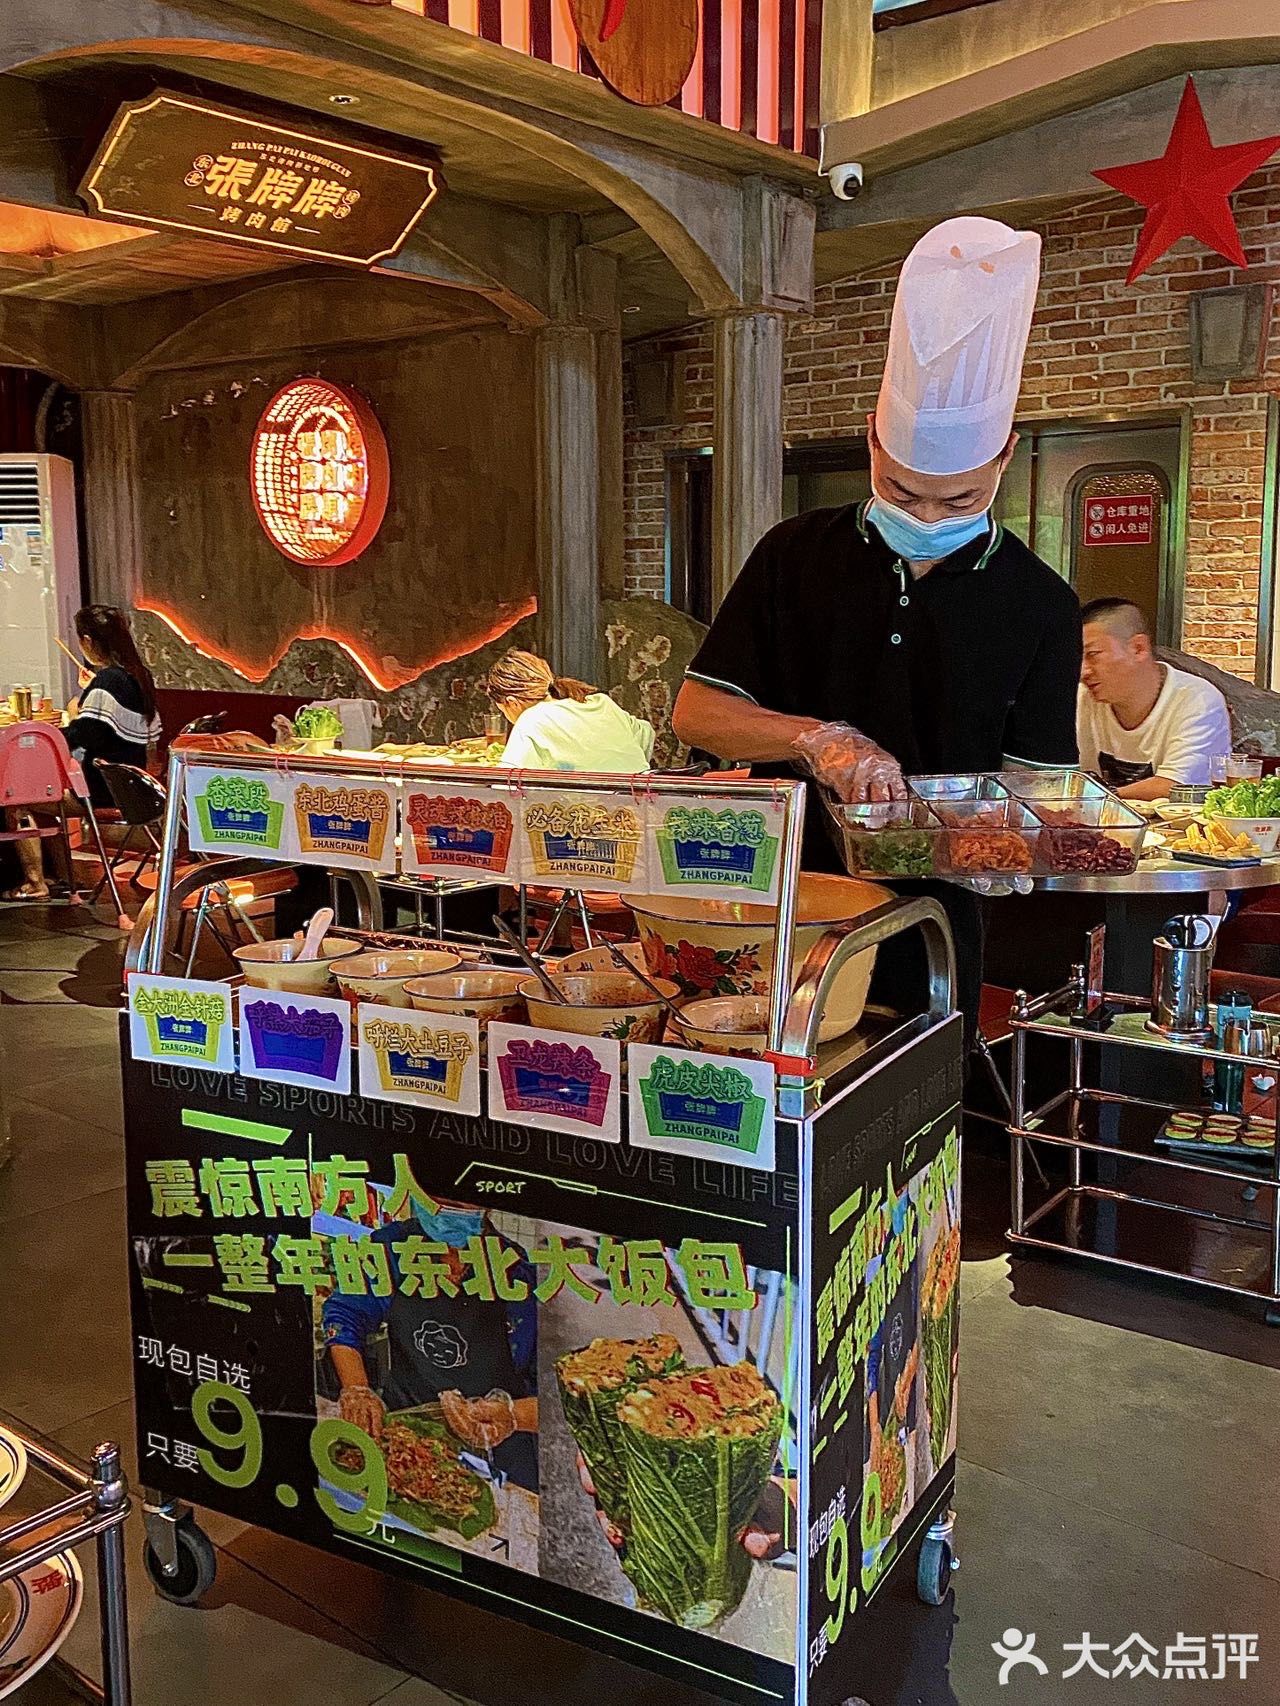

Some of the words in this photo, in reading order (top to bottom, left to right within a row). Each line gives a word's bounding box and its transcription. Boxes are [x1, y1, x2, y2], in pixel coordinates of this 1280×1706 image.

[1106, 505, 1150, 517] 仓库重地
[1105, 522, 1149, 534] 闲人免进
[207, 776, 270, 811] 香菜段
[297, 786, 388, 819] 东北鸡蛋酱
[526, 805, 635, 837] 必备花生米
[214, 830, 267, 843] ZHANGPAIPAI
[312, 840, 368, 855] ZHANGPAIPAI
[430, 852, 491, 867] ZHANGPAIPAI
[550, 861, 616, 876] ZHANGPAIPAI
[680, 870, 752, 884] ZHANGPAIPAI
[160, 1042, 206, 1056] ZHANGPAIPAI
[392, 1077, 447, 1094] ZHANGPAIPAI
[651, 1058, 752, 1101] 虎皮尖椒
[151, 1064, 248, 1100] LOVE
[258, 1080, 416, 1133] SPORTS
[429, 1111, 531, 1154] AND
[546, 1132, 676, 1186] LOVE
[692, 1156, 799, 1211] LIFE
[665, 1123, 739, 1144] ZHANGPAIPAI
[145, 1153, 441, 1222] 震惊南方人
[475, 1180, 527, 1194] SPORT
[163, 1233, 760, 1311] 一整年的东北大饭包
[138, 1335, 250, 1394] 现包自选
[146, 1431, 199, 1474] 只要
[191, 1379, 388, 1533] 9.9
